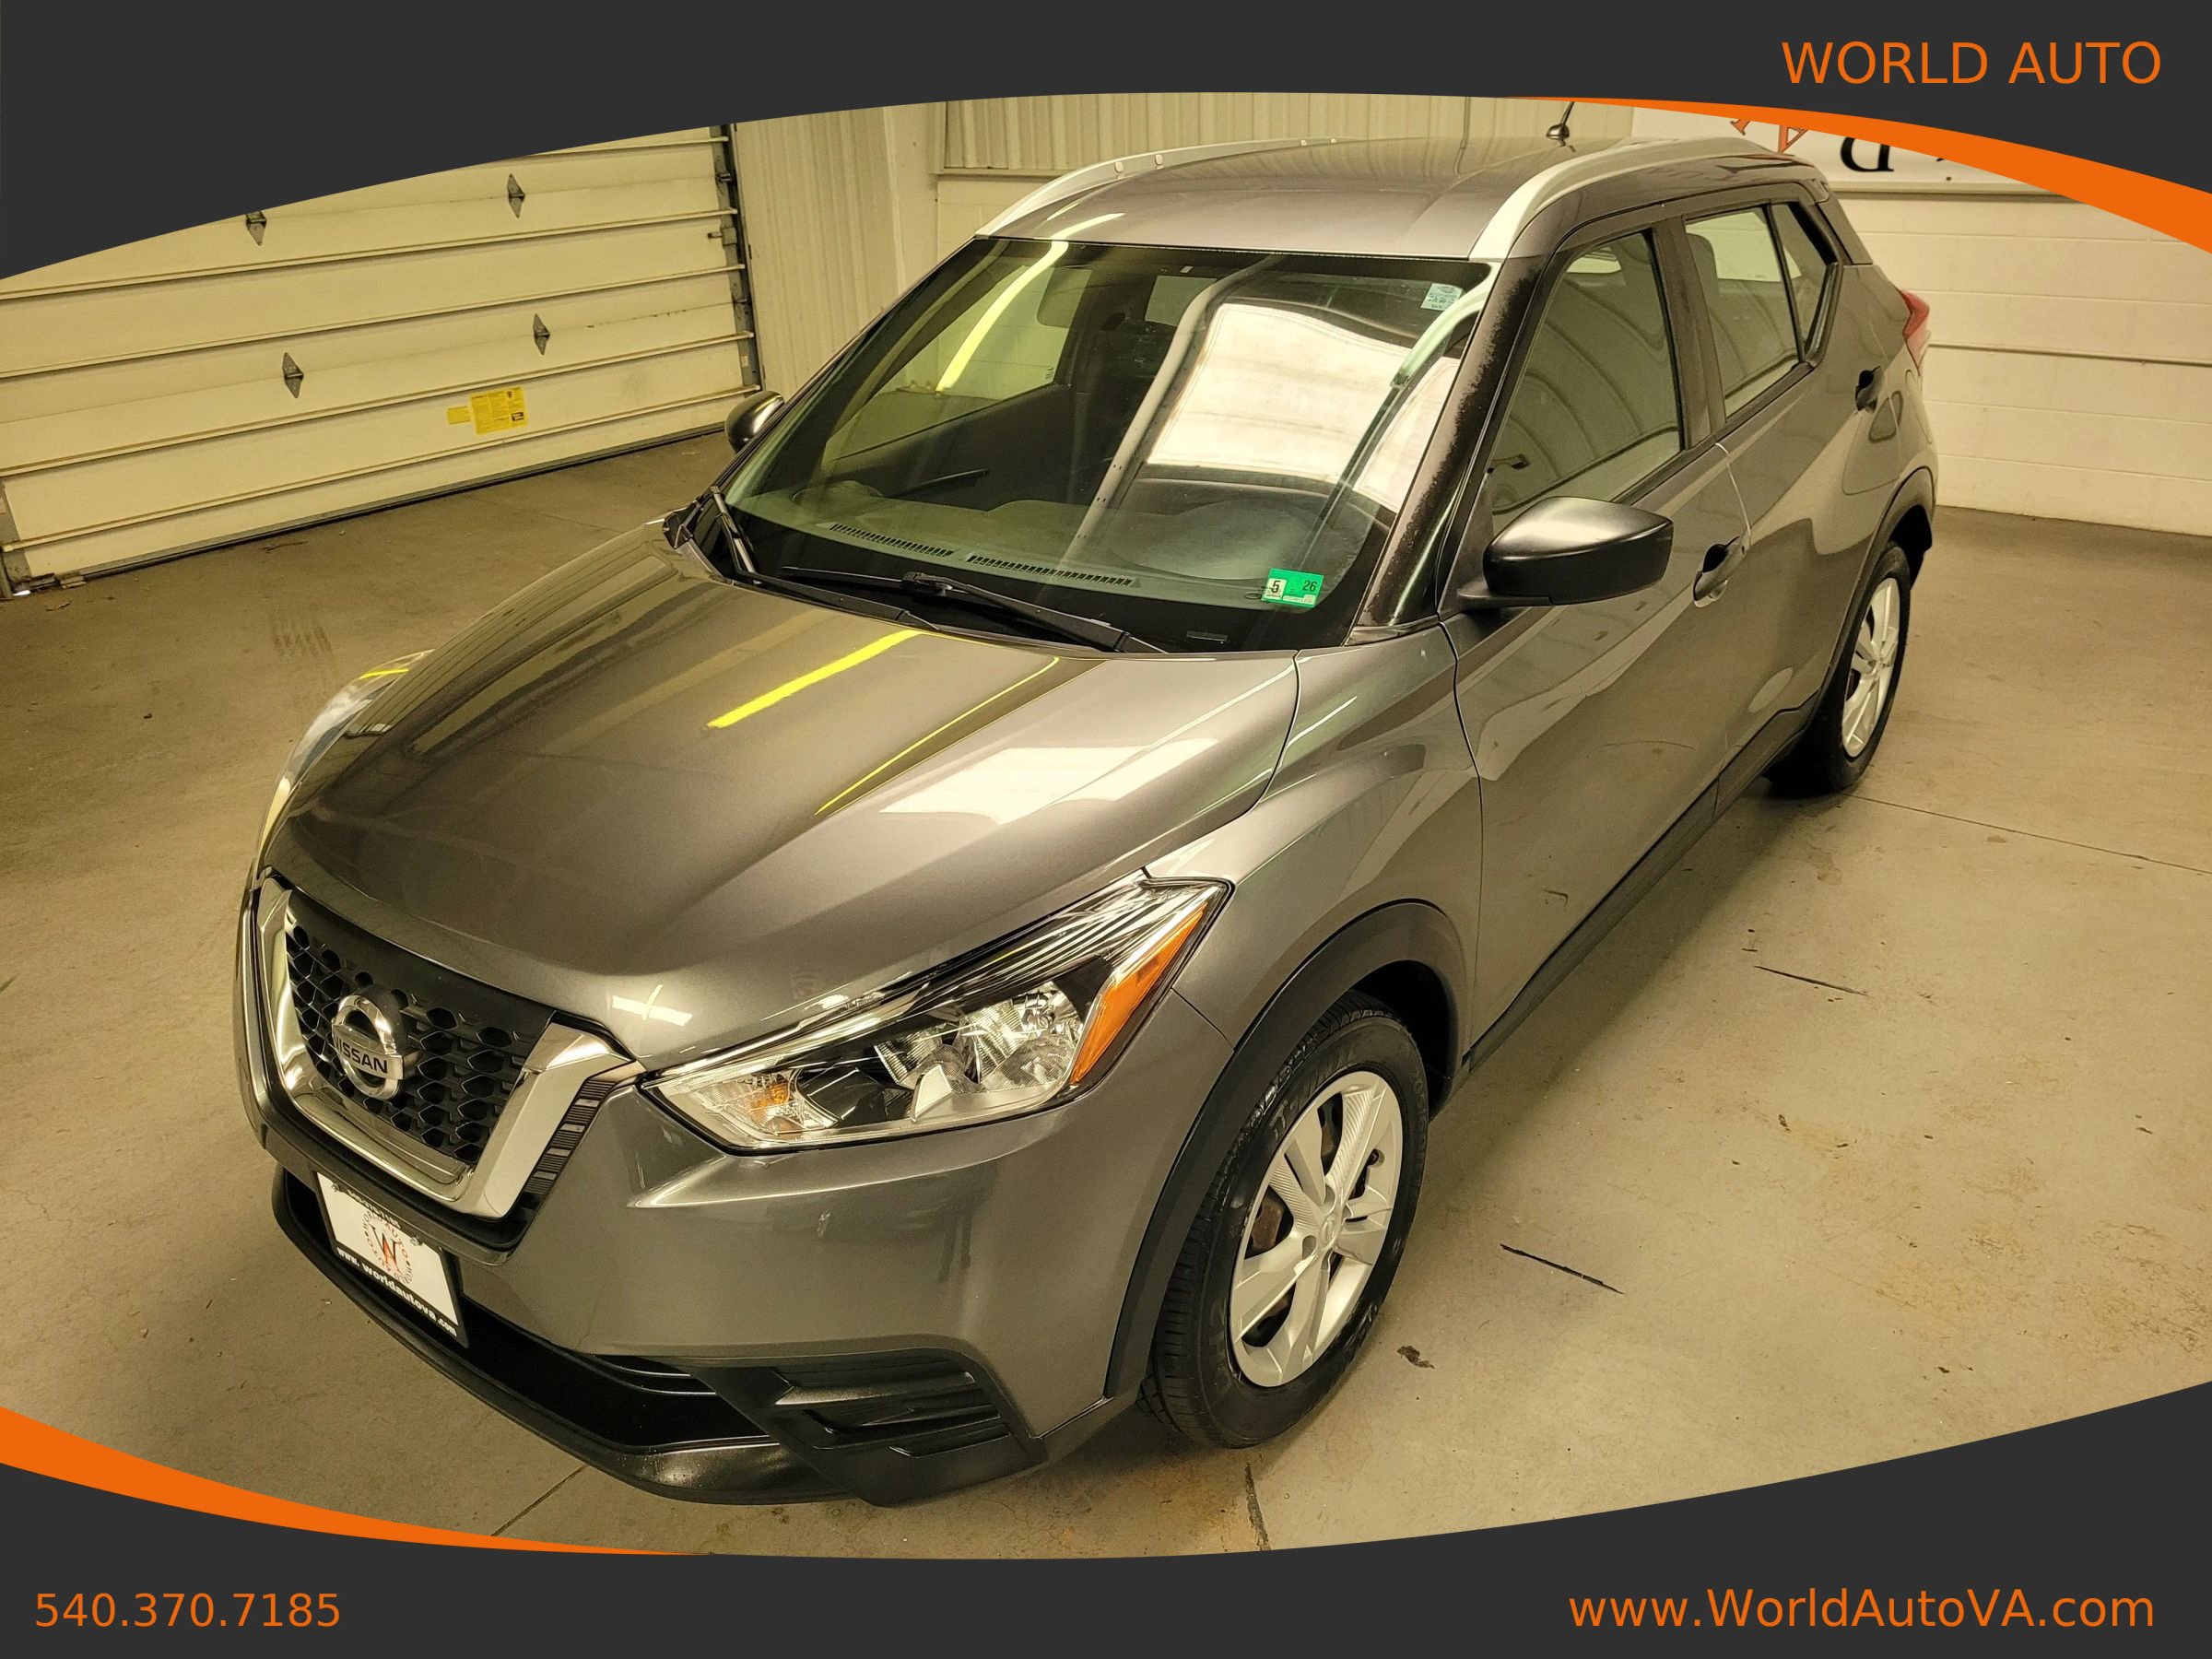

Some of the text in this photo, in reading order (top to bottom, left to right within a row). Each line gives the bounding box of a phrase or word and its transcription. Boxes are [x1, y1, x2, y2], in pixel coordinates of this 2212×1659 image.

[1271, 580, 1317, 593] 5 26
[334, 1033, 388, 1074] NISSAN
